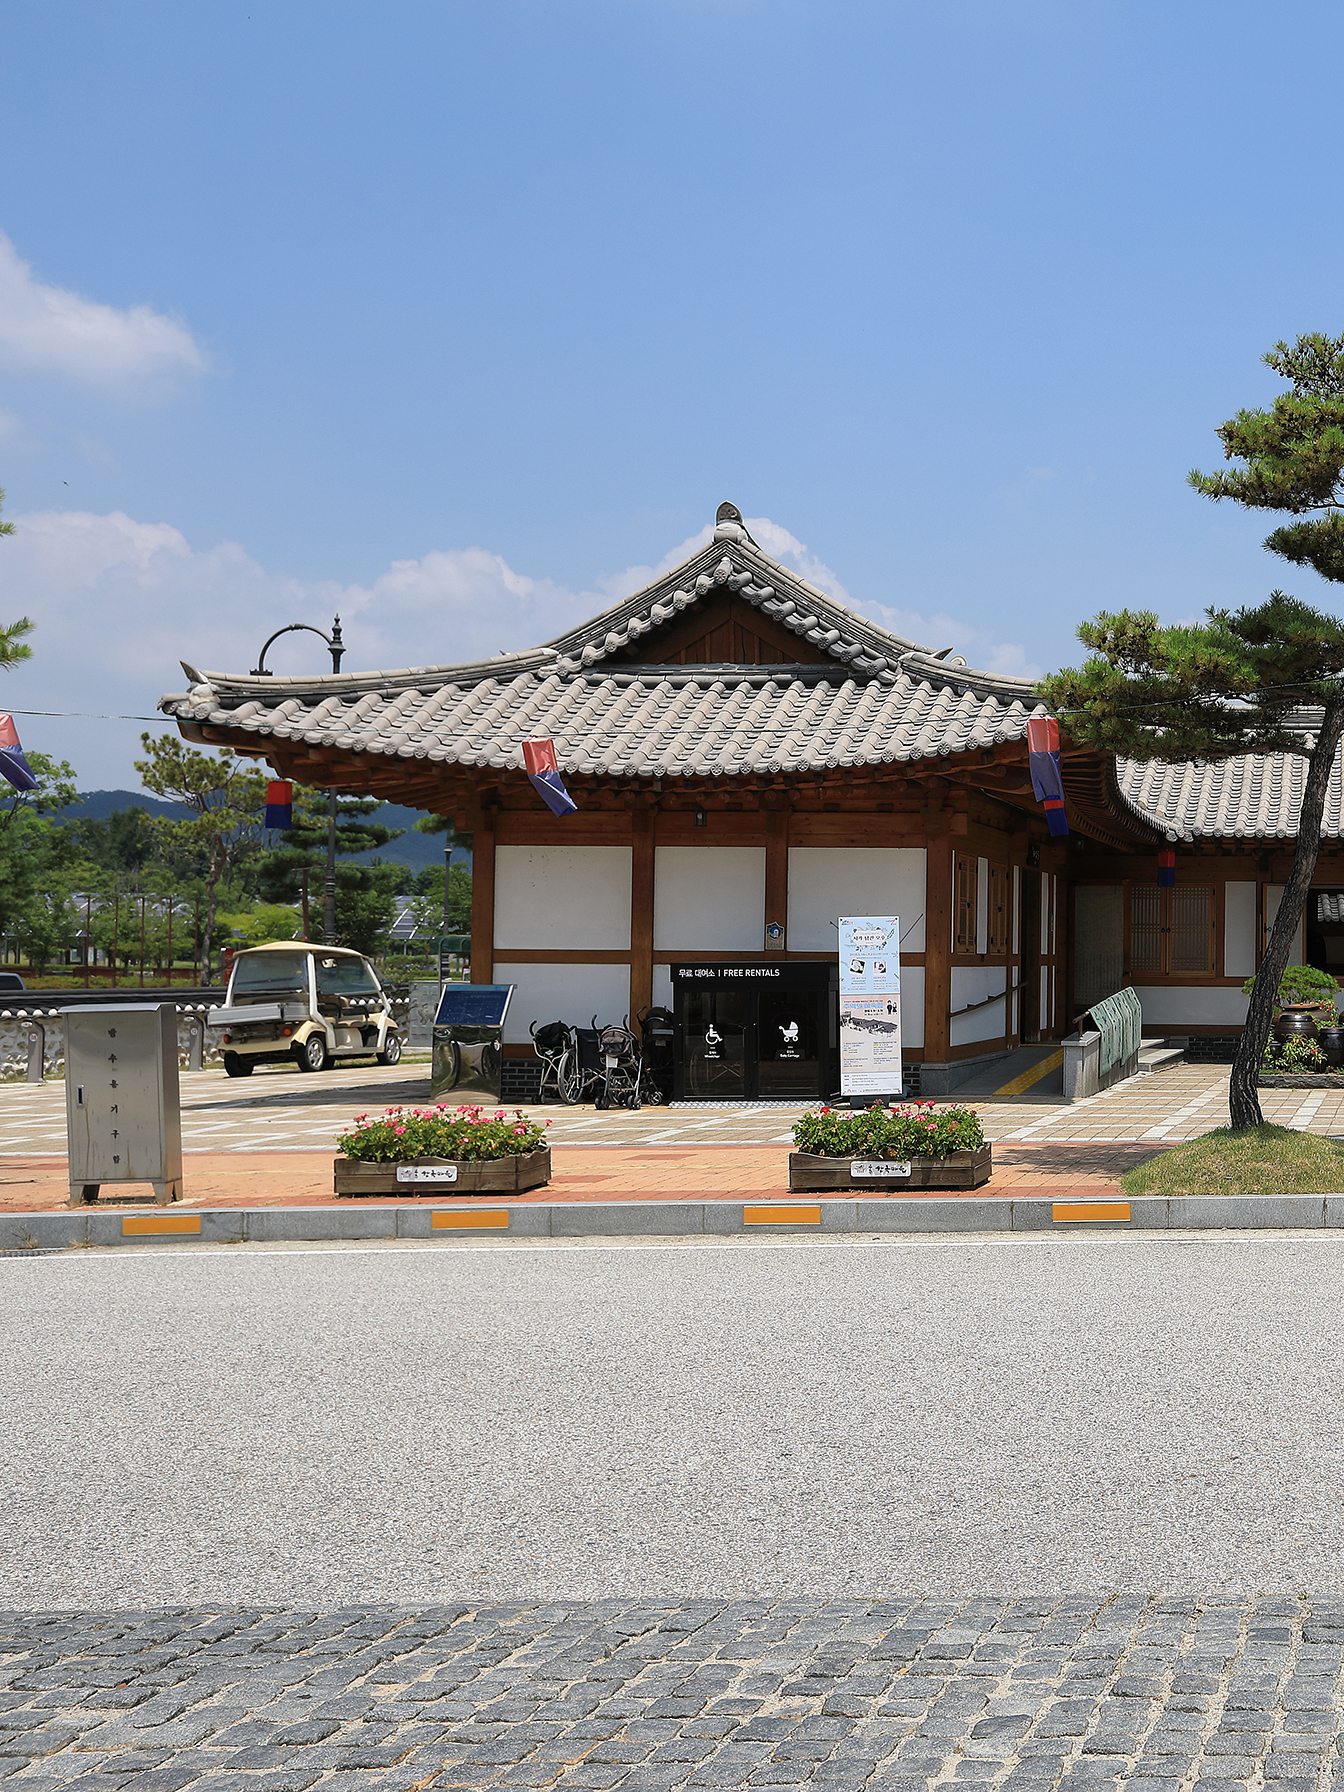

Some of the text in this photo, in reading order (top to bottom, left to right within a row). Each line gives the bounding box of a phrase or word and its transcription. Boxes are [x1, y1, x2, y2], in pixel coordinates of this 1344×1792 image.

[678, 969, 715, 977] 무료 대여소
[724, 969, 780, 977] FREE RENTALS
